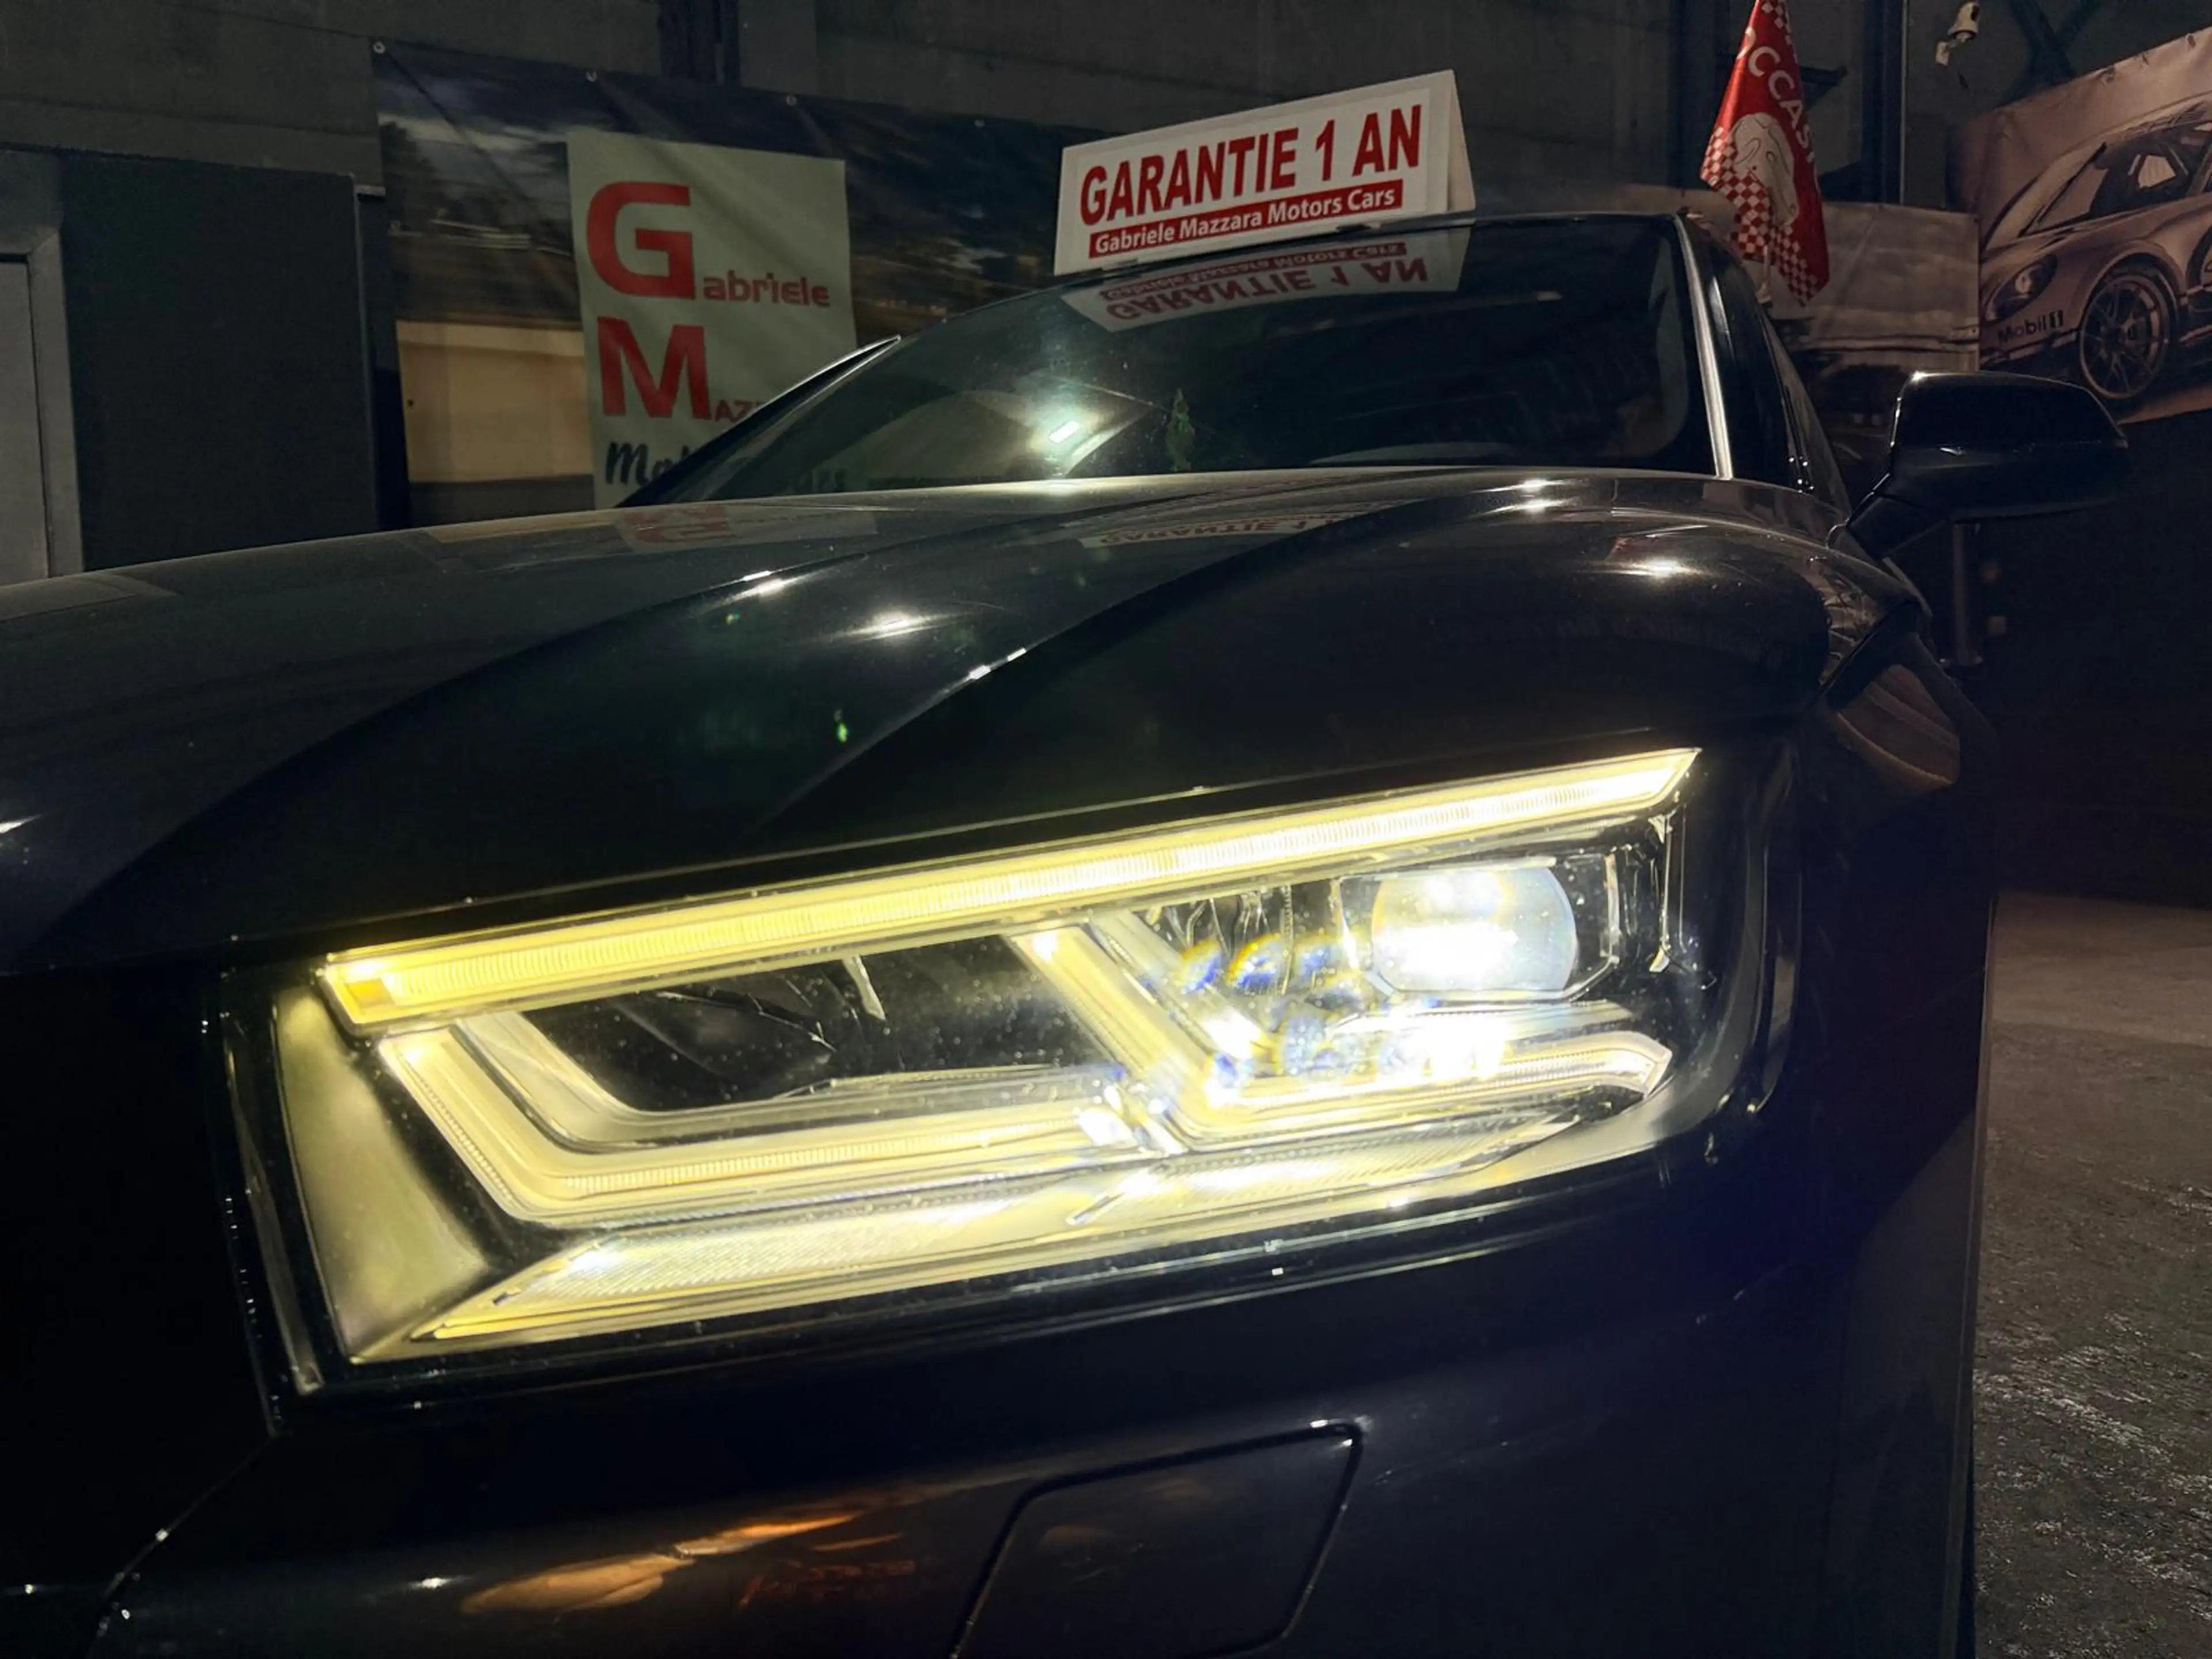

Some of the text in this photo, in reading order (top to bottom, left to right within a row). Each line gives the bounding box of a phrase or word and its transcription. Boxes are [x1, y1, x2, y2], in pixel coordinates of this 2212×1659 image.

[1080, 104, 1422, 226] GARANTIE 1 AN
[1096, 188, 1395, 253] Gabriele Mazzara Motors Cars
[586, 181, 830, 306] Gabriele
[597, 317, 766, 423] MAZ
